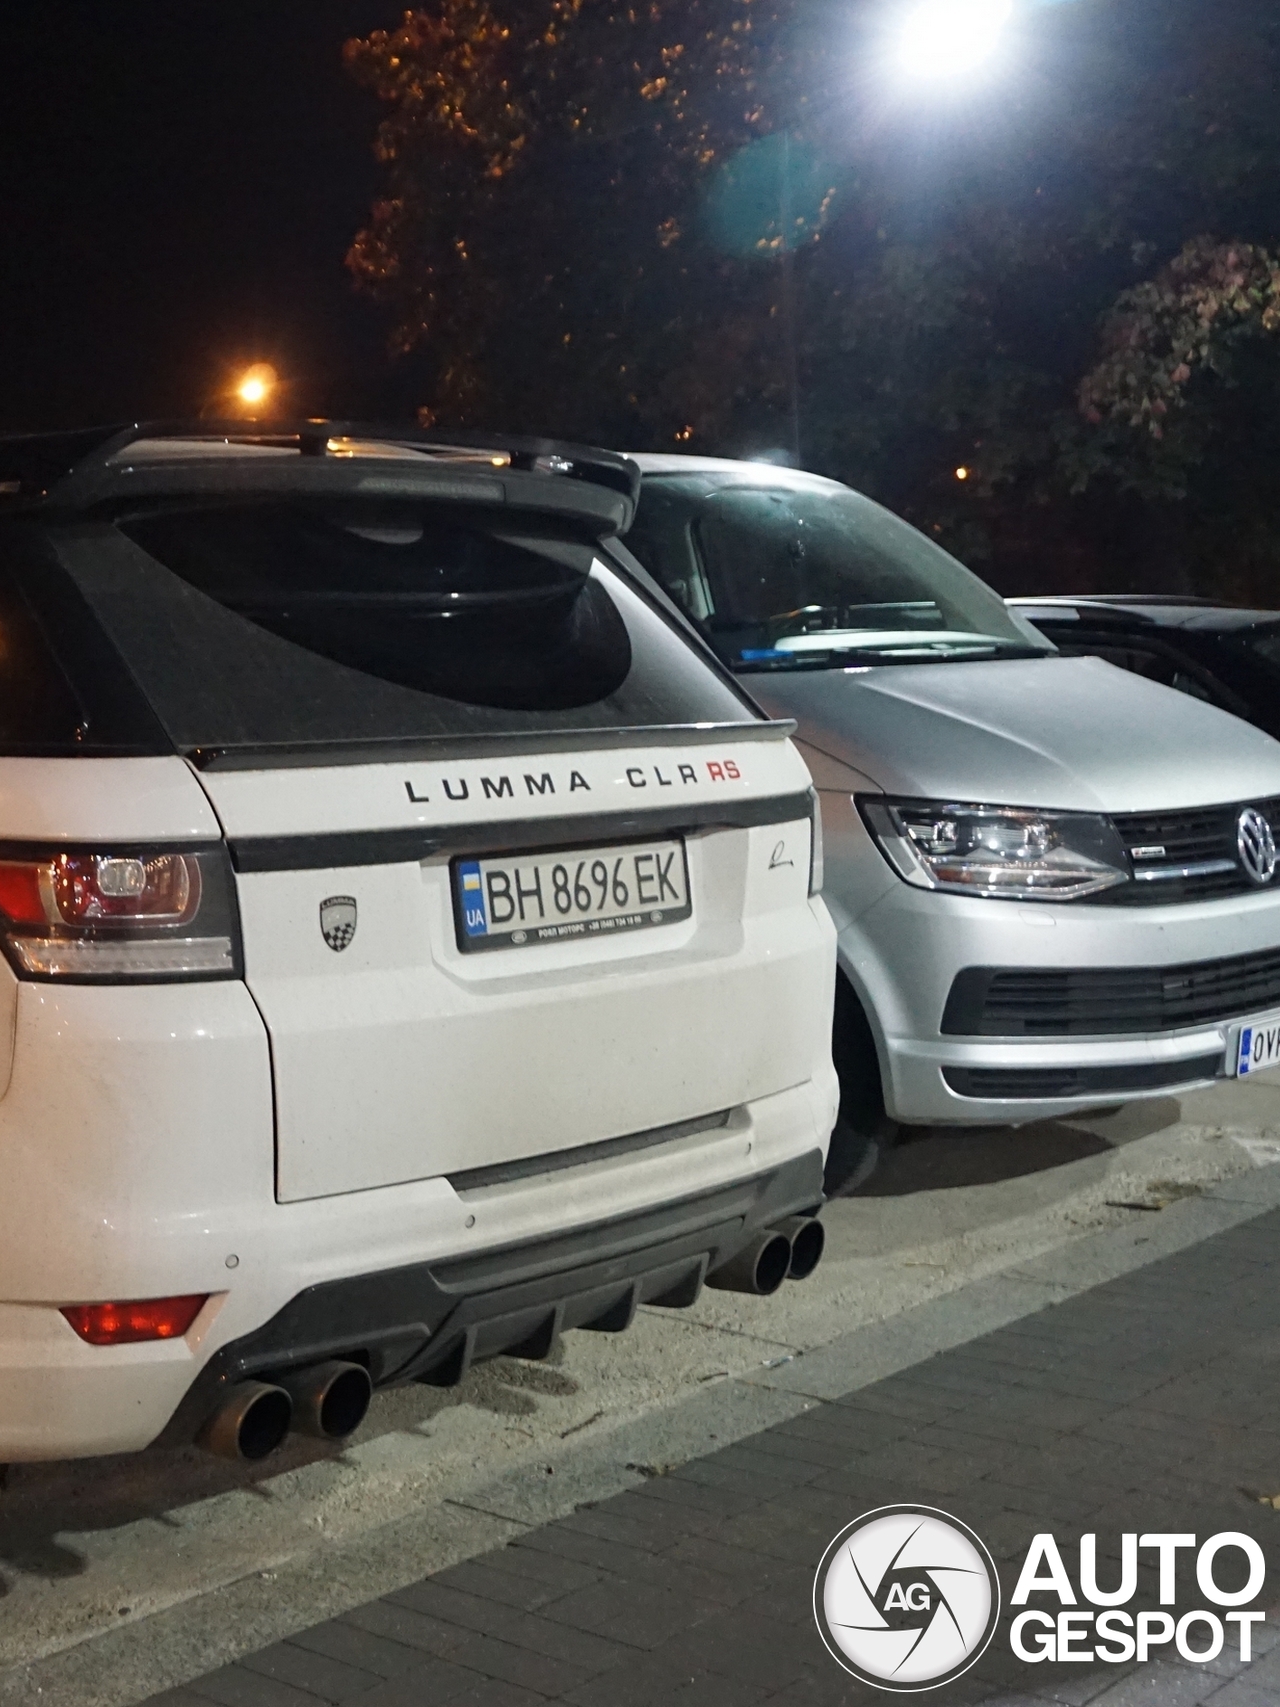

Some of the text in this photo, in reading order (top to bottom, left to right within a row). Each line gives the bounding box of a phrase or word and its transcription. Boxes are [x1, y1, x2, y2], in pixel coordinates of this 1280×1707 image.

[404, 759, 742, 803] LUMMA CLR RS
[485, 851, 680, 925] BH 8696 EK
[466, 908, 485, 927] UA
